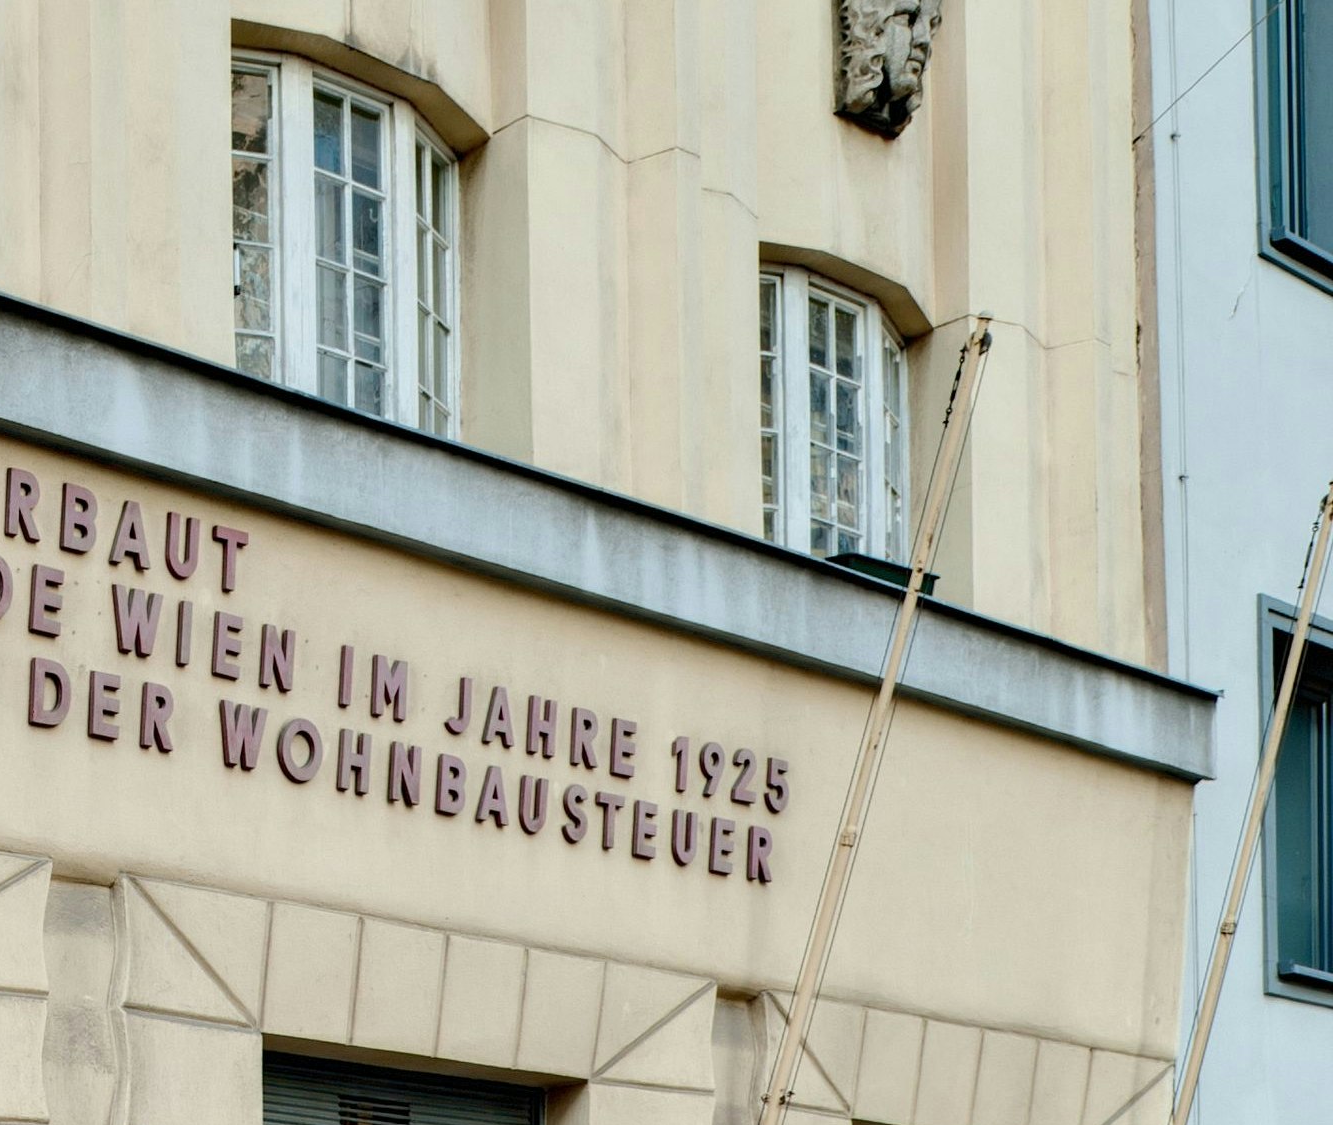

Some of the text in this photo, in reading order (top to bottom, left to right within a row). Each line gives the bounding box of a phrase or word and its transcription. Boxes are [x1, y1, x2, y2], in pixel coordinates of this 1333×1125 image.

[28, 656, 174, 753] DER
[219, 699, 773, 885] WOHNBAUSTEUER
[110, 583, 296, 693] WIEN
[338, 644, 409, 723] IM
[443, 676, 638, 780] JAHRE
[671, 735, 791, 814] 1925
